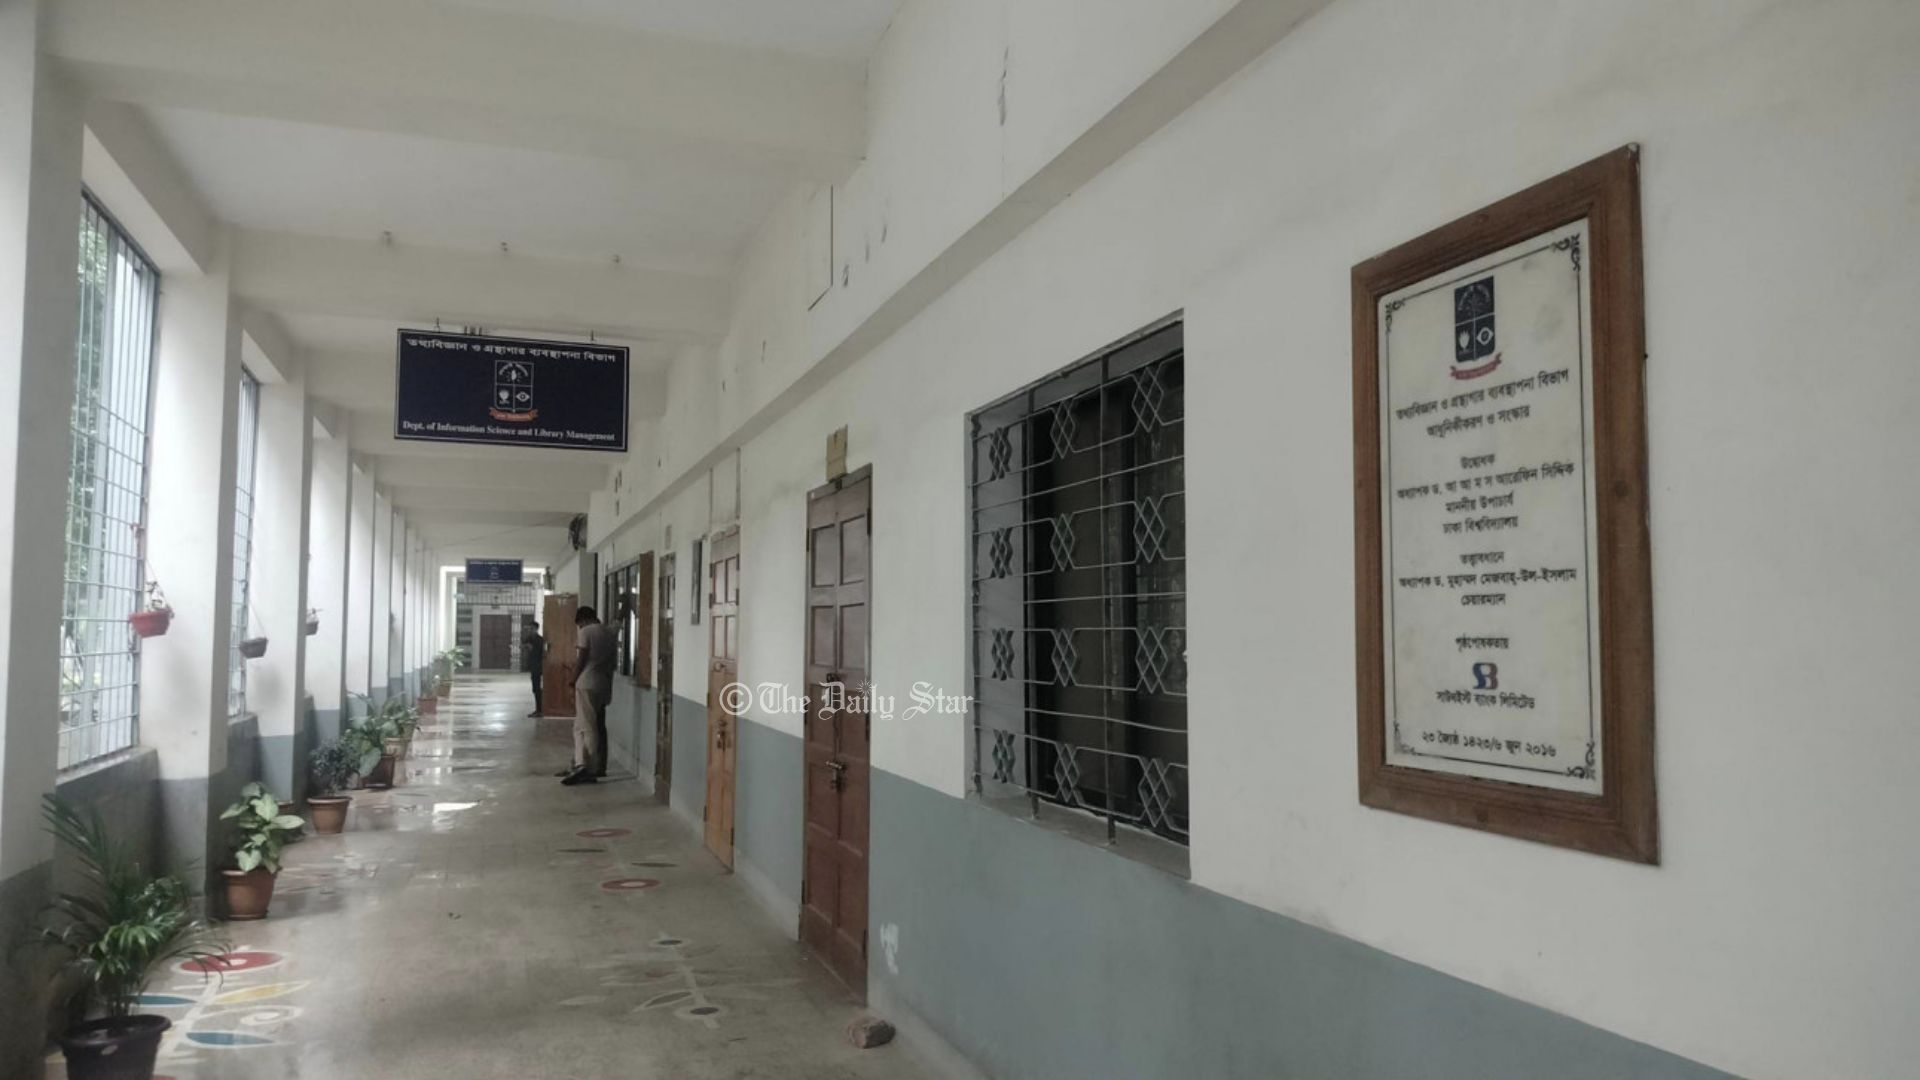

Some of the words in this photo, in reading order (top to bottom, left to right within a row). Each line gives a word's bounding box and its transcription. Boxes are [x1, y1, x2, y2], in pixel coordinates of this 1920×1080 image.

[471, 344, 480, 352] ও
[530, 348, 581, 360] ব্যবস্থাপনা
[583, 351, 616, 362] বিভাগ
[1440, 399, 1448, 410] ও
[1488, 377, 1535, 399] ব্যবস্থাপনা
[1537, 368, 1569, 388] বিভাগ
[1427, 415, 1484, 438] আধুনিকীকরণ
[1486, 413, 1495, 425] ও
[1497, 404, 1530, 422] সংস্কার
[403, 421, 425, 431] Dept.
[427, 422, 436, 430] of
[437, 422, 486, 433] Information
[487, 426, 516, 435] Science
[534, 428, 563, 439] Library
[566, 430, 615, 441] Management
[1397, 485, 1429, 499] অধ্যাপক
[1431, 483, 1442, 495] ড.
[1445, 480, 1457, 492] আ
[1460, 478, 1471, 490] আ
[1474, 476, 1481, 487] ম
[1483, 475, 1492, 487] স
[1495, 466, 1538, 485] আরেফিন
[1445, 496, 1477, 512] মাননীয়
[1479, 491, 1514, 509] উপাচার্য
[1442, 522, 1462, 534] ঢাকা
[1464, 516, 1519, 533] বিশ্ববিদ্যালয়
[1399, 576, 1431, 588] অধ্যাপক
[1433, 576, 1445, 588] ড.
[1461, 593, 1506, 606] চেয়ারম্যান
[1499, 691, 1535, 709] লিমিটেড
[1505, 739, 1522, 755] জুন
[1526, 742, 1556, 757] ২০১৬
